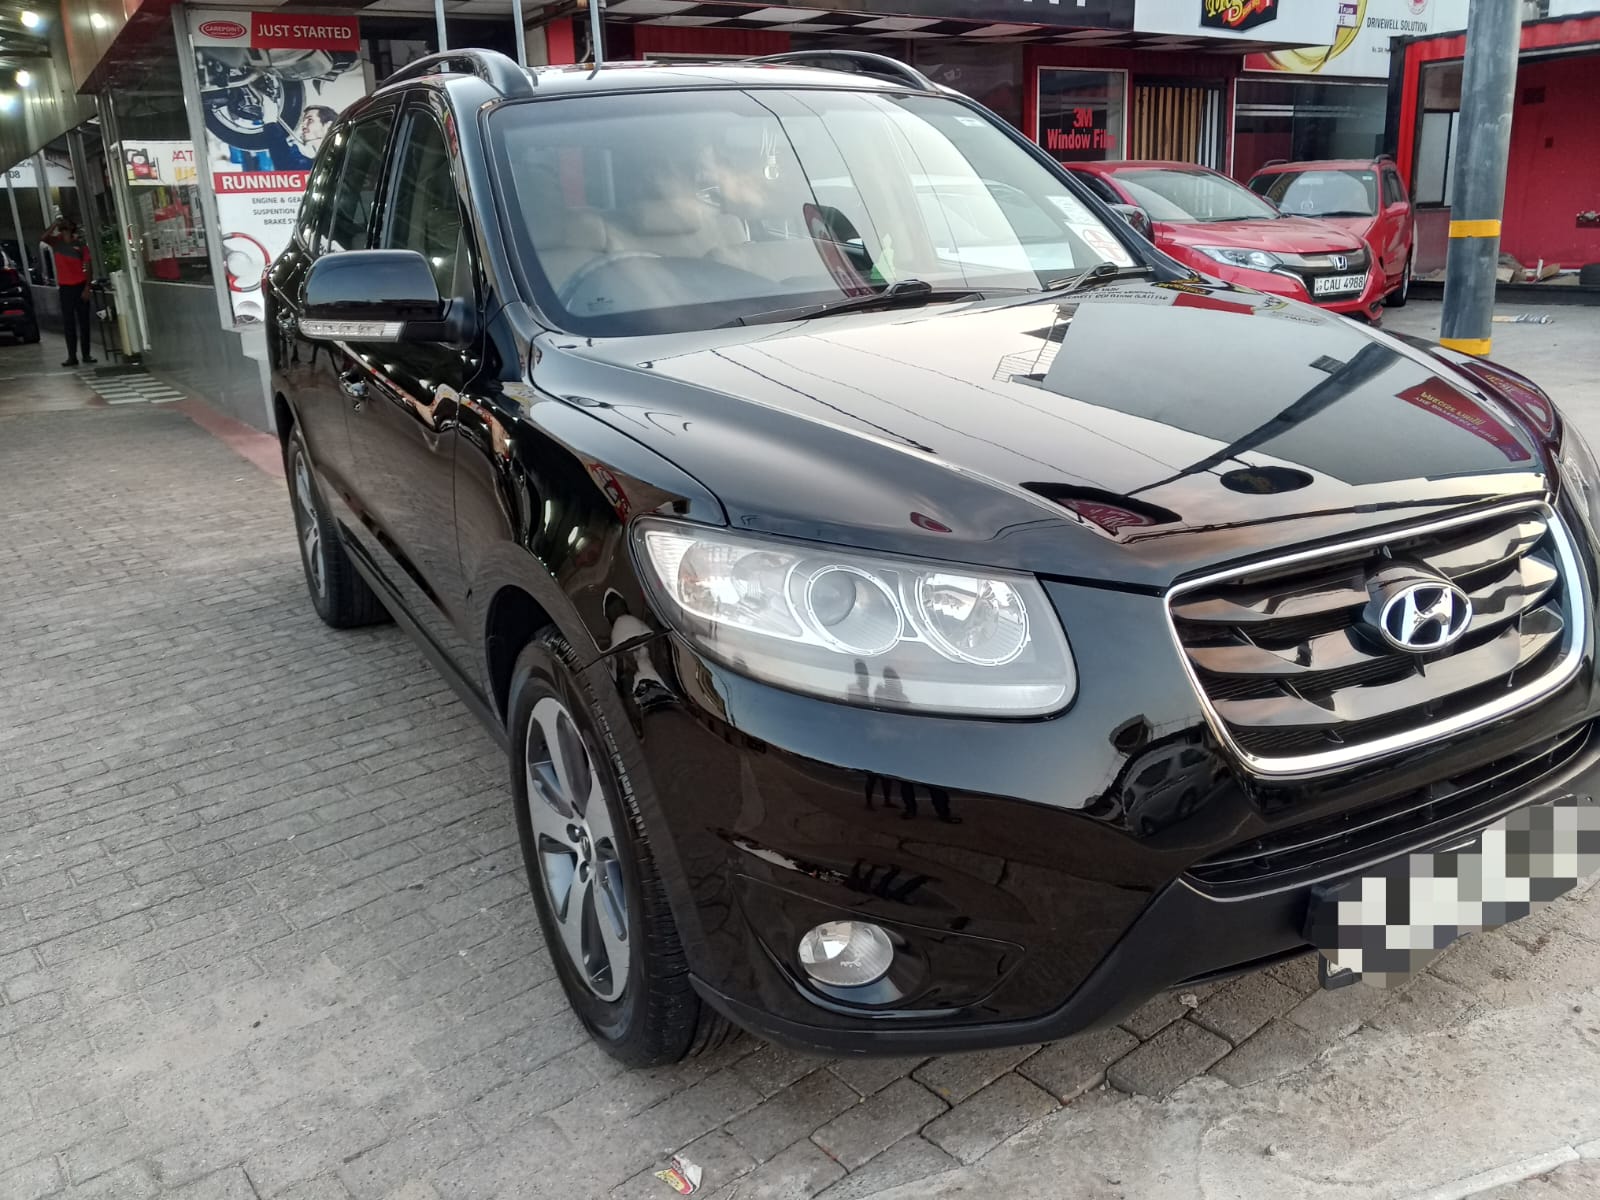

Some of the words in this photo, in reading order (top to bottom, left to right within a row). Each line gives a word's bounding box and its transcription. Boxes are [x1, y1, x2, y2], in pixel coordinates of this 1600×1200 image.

[258, 24, 290, 37] JUST
[293, 25, 352, 39] STARTED
[1366, 17, 1399, 30] DRIVEWELL
[1400, 19, 1428, 32] SOLUTION
[1072, 107, 1093, 128] 3M
[1047, 128, 1091, 150] Window
[221, 174, 302, 190] RUNNING
[253, 208, 296, 216] SUSPENTION
[264, 218, 287, 226] BRAKE
[1323, 279, 1342, 291] CAU
[1343, 276, 1364, 289] 4988
